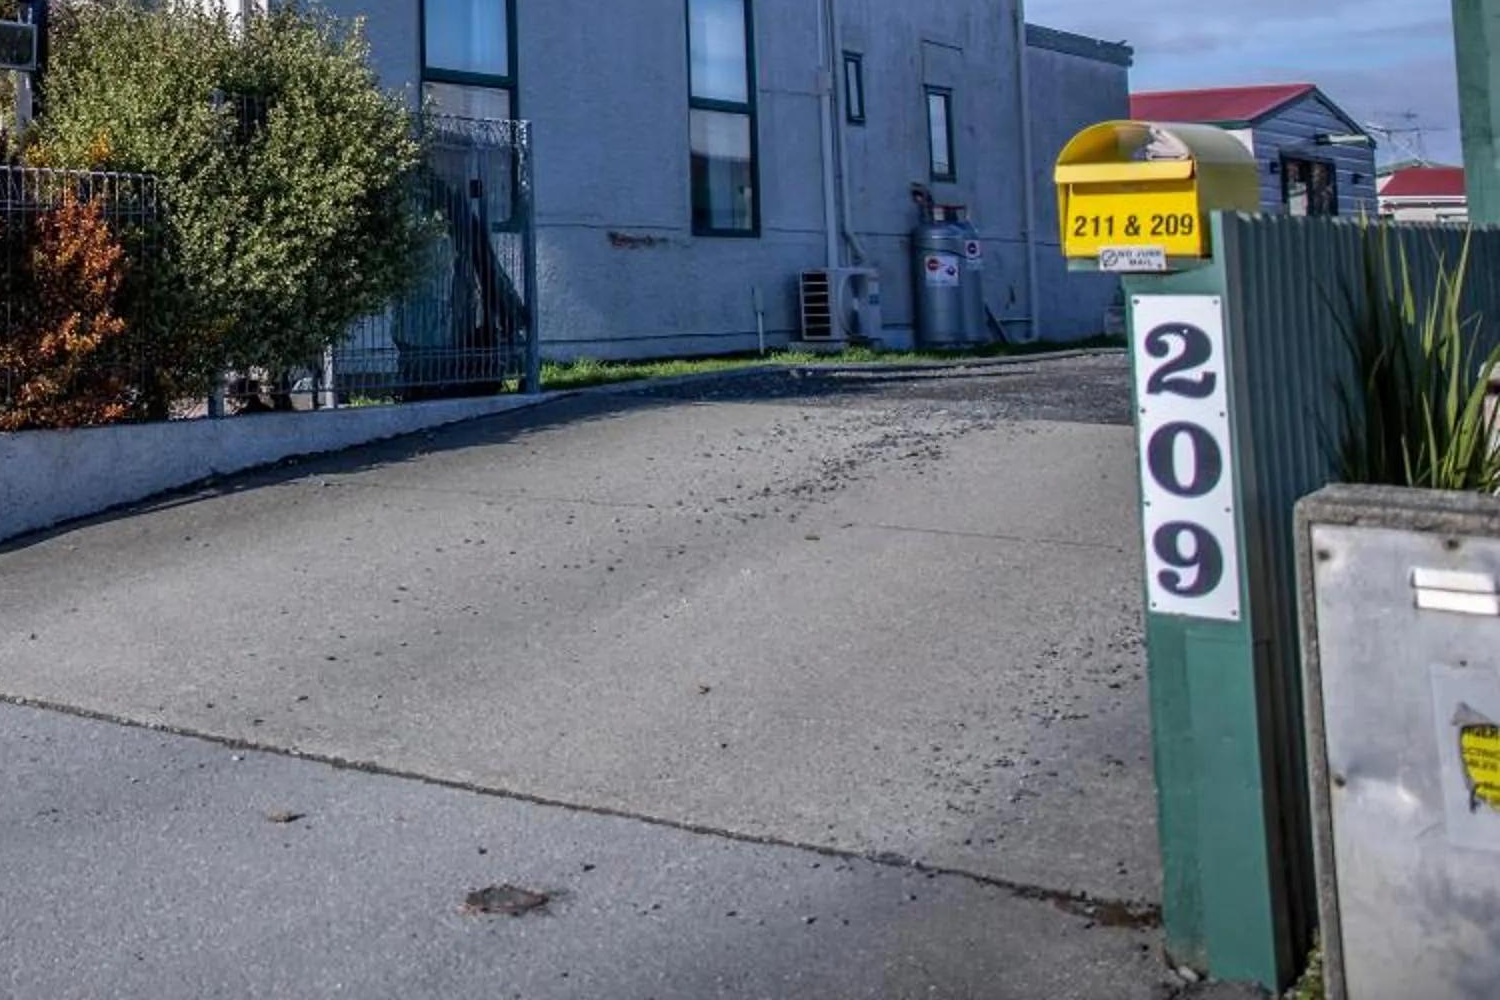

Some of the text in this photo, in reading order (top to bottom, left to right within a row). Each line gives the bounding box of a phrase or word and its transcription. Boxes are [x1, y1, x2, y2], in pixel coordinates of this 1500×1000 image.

[1073, 213, 1194, 237] 211 & 209
[1144, 322, 1225, 598] 209
